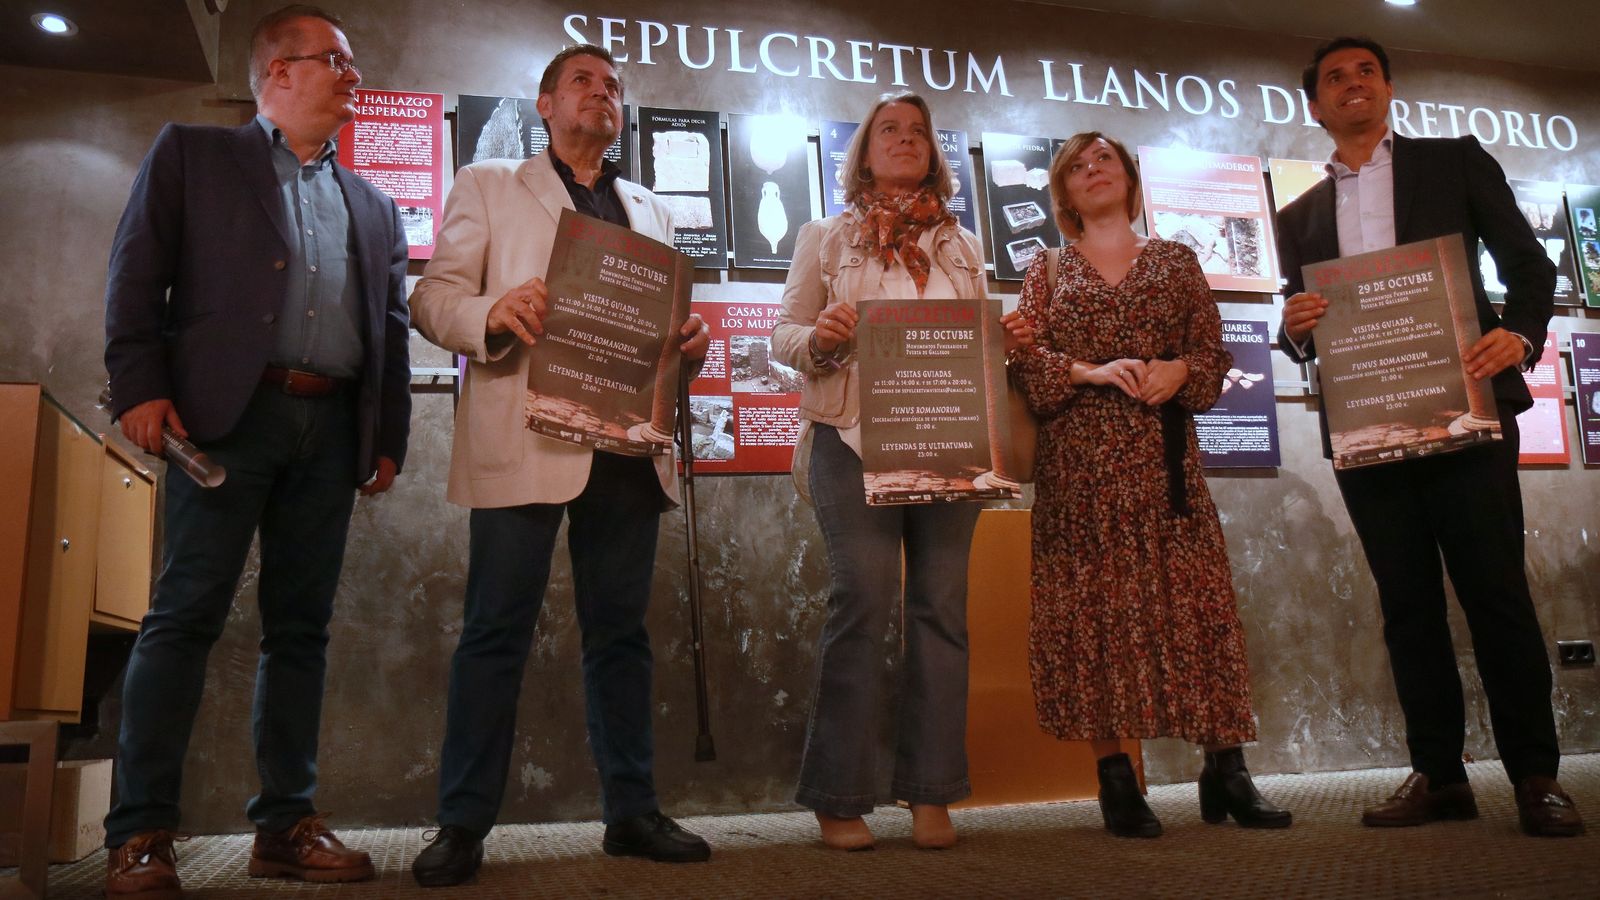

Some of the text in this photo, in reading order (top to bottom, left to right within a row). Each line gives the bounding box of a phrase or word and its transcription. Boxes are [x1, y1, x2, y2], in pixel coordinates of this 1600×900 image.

[563, 14, 1013, 97] SEPULCRETUM
[1039, 59, 1240, 118] LLANOS
[1389, 99, 1577, 151] RETORIO
[365, 94, 433, 108] HALLAZGO
[353, 105, 428, 119] NESPERADO
[830, 128, 838, 138] 4
[603, 256, 614, 267] 29
[618, 260, 628, 270] DE
[1358, 284, 1370, 294] 29
[1373, 281, 1384, 291] DE
[583, 293, 609, 306] VISITAS
[727, 306, 762, 317] CASAS
[722, 318, 742, 328] LOS
[1352, 323, 1380, 334] VISITAS
[905, 330, 916, 339] 29
[920, 330, 930, 339] DE
[1576, 338, 1586, 348] 10
[549, 364, 583, 380] LEYENDAS
[585, 374, 592, 382] DE
[1346, 396, 1384, 408] LEYENDAS
